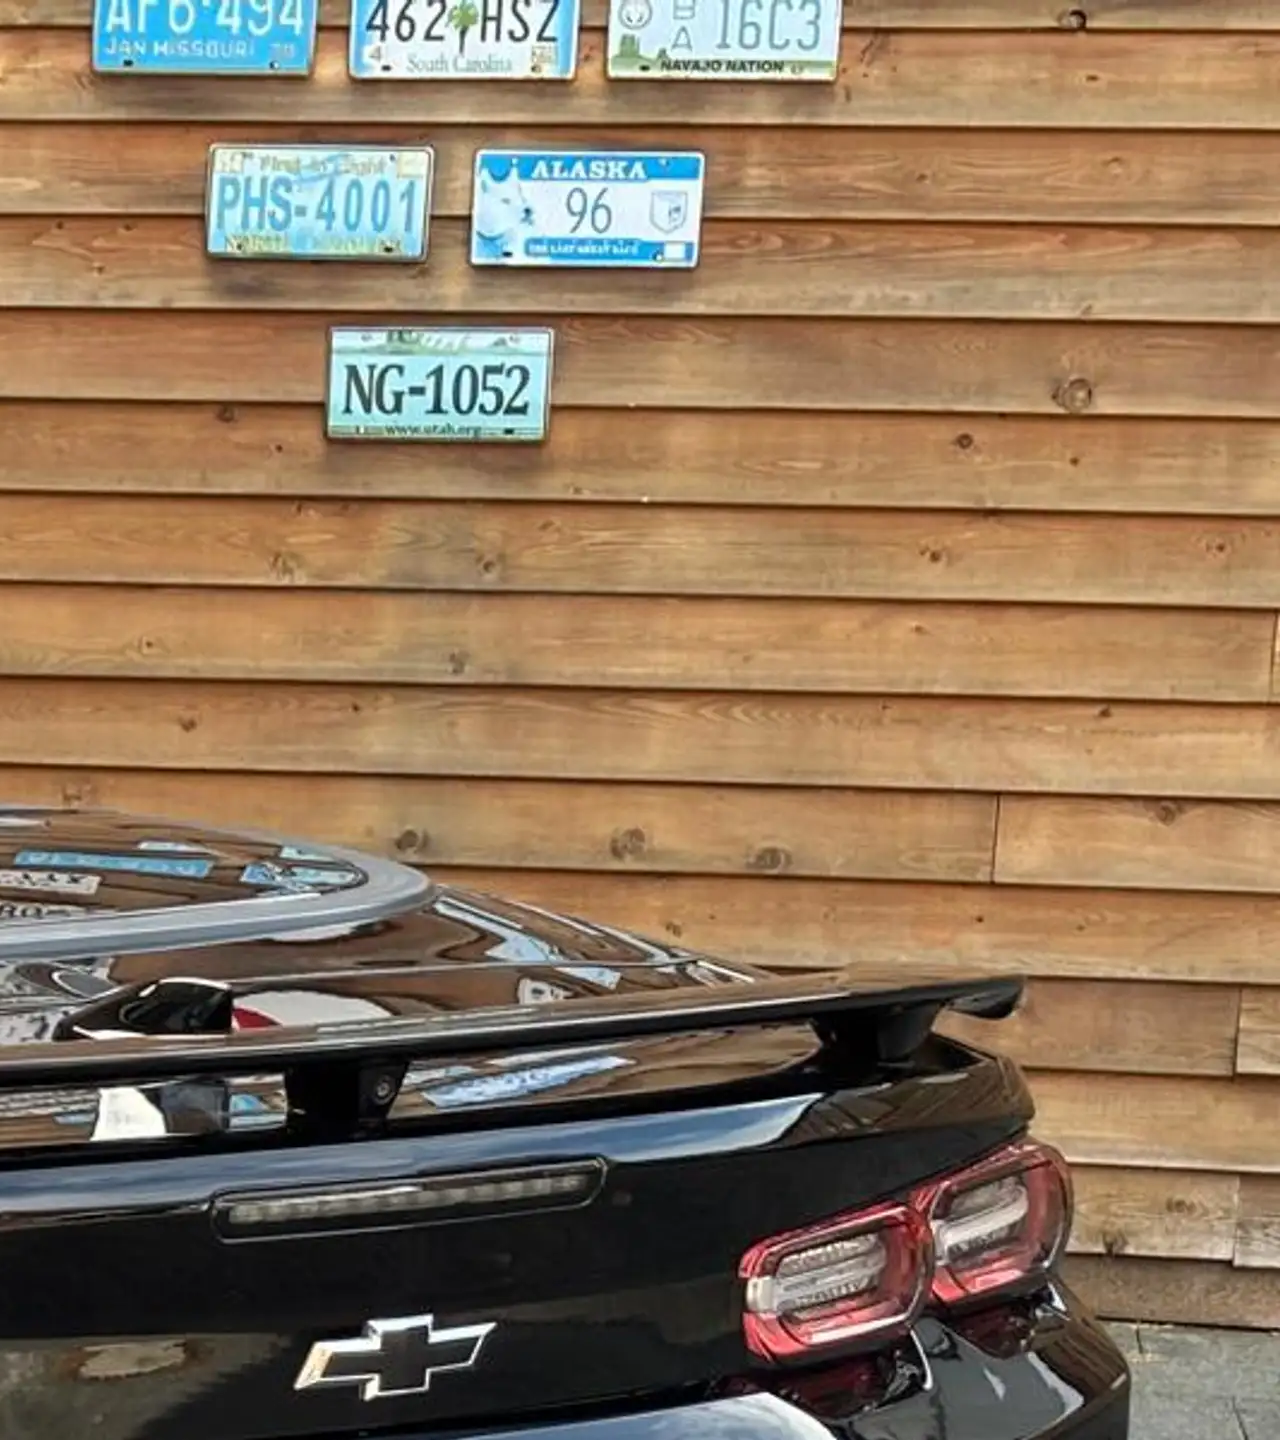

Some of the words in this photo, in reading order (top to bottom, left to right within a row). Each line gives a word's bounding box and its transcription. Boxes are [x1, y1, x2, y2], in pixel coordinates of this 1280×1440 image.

[366, 0, 447, 42] 462
[715, 0, 822, 51] 16C3
[154, 40, 255, 59] MISSOURI
[406, 54, 449, 74] South
[452, 54, 514, 74] Carolina
[660, 60, 722, 73] NAVAJO
[725, 60, 785, 74] NATION
[531, 160, 648, 180] ALASKA
[216, 175, 417, 233] PHS-4001
[565, 187, 613, 234] 96
[342, 363, 531, 416] NG-1052
